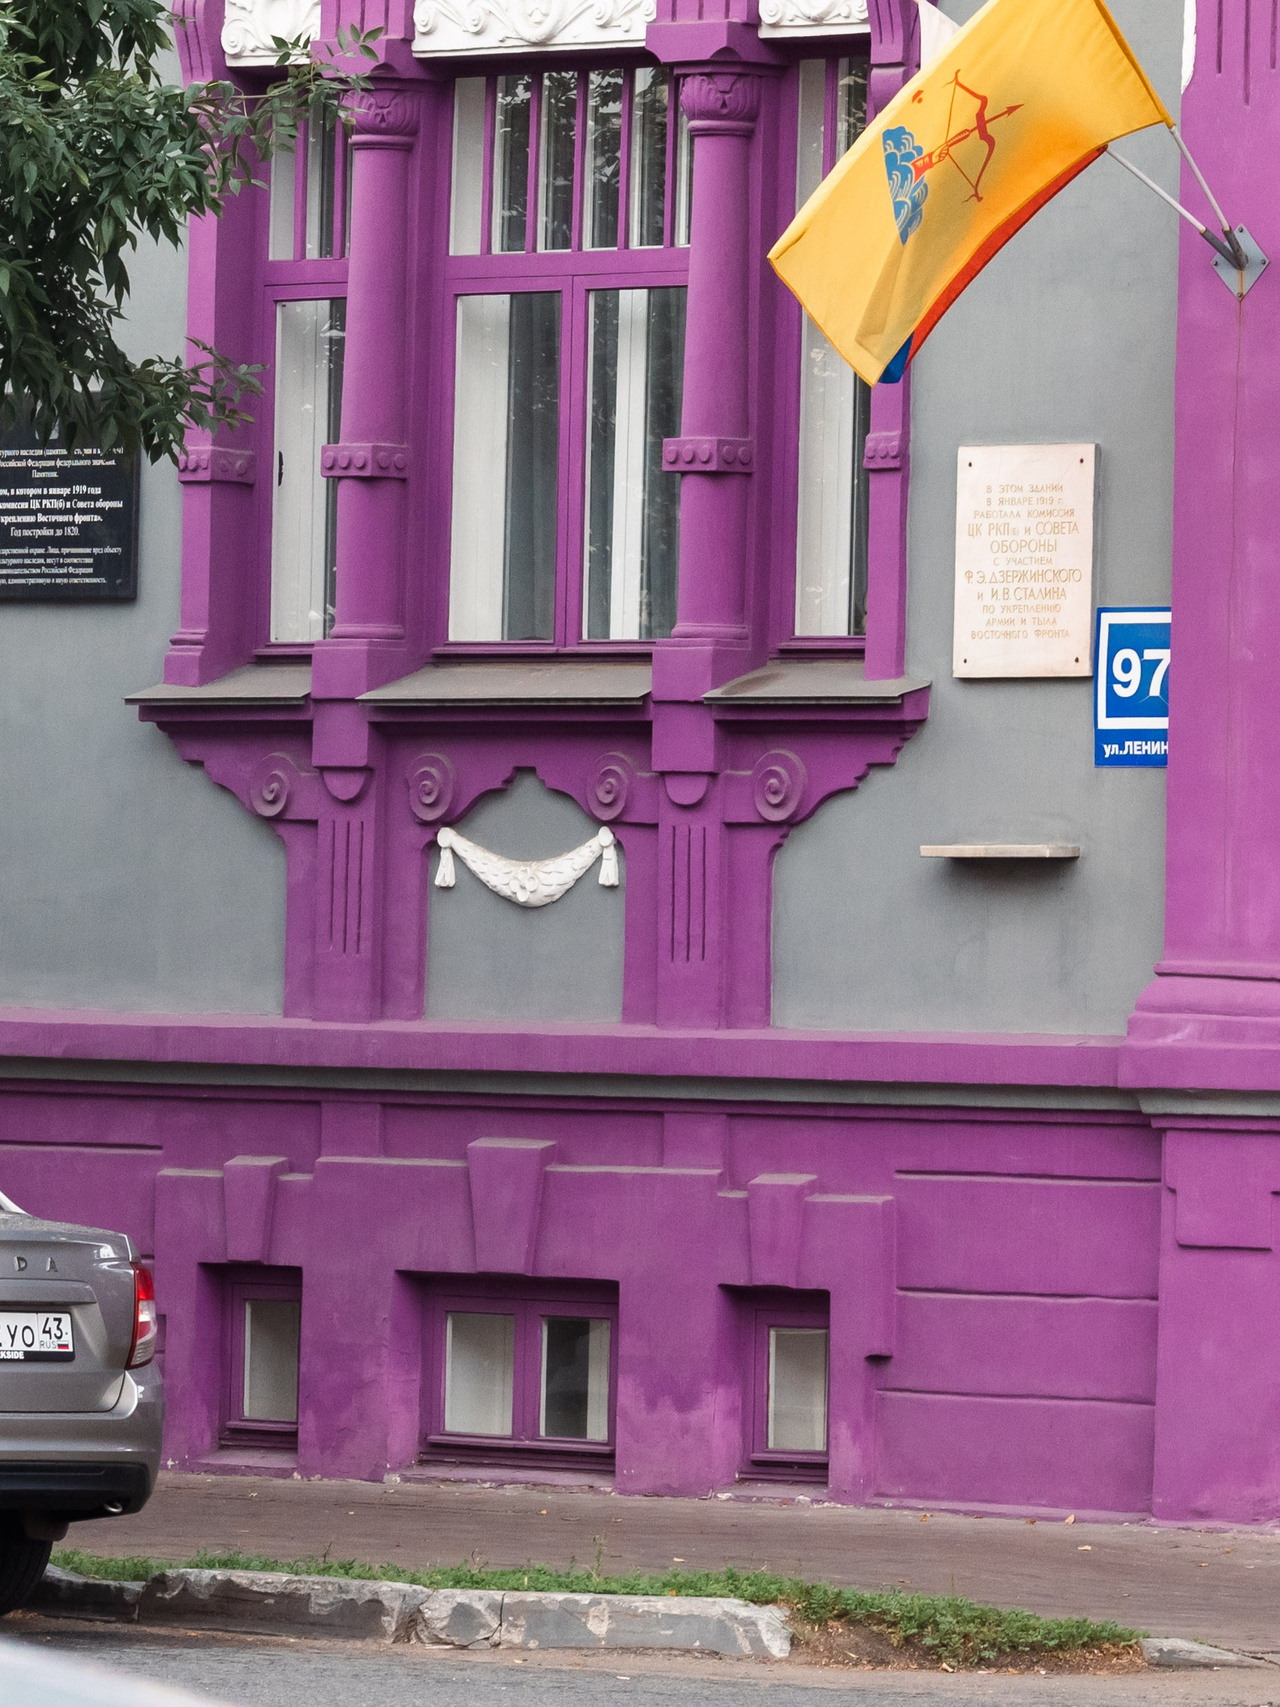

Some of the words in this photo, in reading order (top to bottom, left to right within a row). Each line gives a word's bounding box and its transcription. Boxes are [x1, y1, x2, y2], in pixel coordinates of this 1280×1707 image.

[16, 487, 42, 497] котором
[48, 487, 71, 497] январе
[72, 484, 87, 495] 1919
[87, 486, 102, 495] года
[985, 484, 992, 494] В
[998, 484, 1024, 494] ЭТОМ
[1028, 483, 1064, 493] ЗДАНИИ
[30, 499, 41, 510] ЦК
[42, 499, 65, 510] РКП(б)
[72, 499, 95, 509] Совета
[95, 498, 123, 511] обороны
[985, 497, 992, 507] В
[998, 496, 1034, 506] ЯНВАРЕ
[1036, 495, 1055, 506] 1919
[37, 512, 73, 522] Восточного
[973, 509, 1022, 520] РАБОТАЛА
[1027, 508, 1075, 519] КОМИССИЯ
[10, 526, 21, 538] Год
[22, 526, 54, 539] постройки
[54, 528, 63, 537] до
[64, 526, 80, 536] 1820.
[967, 523, 983, 540] ЦК
[1035, 520, 1080, 536] СОВЕТА
[989, 539, 1058, 554] ОБОРОНЫ
[993, 557, 1001, 567] С
[1005, 555, 1054, 567] УЧАСТИЕМ
[982, 604, 996, 615] ПО
[1000, 603, 1062, 615] УКРЕПЛЕНИЮ
[985, 617, 1016, 628] АРМИИ
[1032, 616, 1058, 627] ТЫЛА
[970, 629, 1030, 641] ВОСТОЧНОГО
[1033, 628, 1071, 640] ФРОНТА
[1112, 648, 1171, 697] 97
[42, 1317, 63, 1340] 43
[39, 1340, 57, 1349] RUS
[0, 1350, 25, 1360] KSIDE
